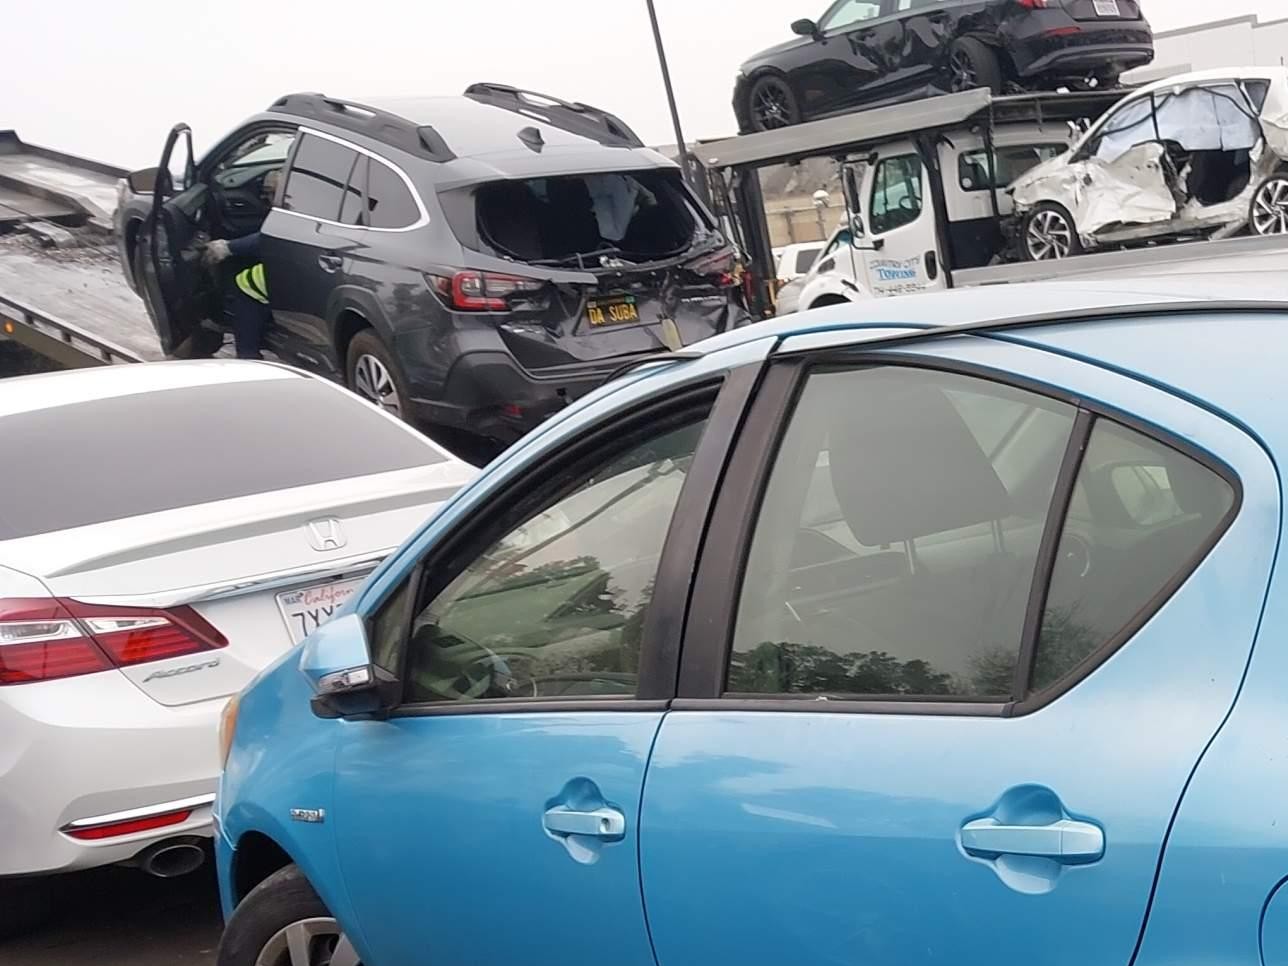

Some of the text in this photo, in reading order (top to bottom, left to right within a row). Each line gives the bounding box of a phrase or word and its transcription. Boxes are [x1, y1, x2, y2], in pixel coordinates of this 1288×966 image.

[588, 303, 638, 324] DA SUBA
[143, 656, 220, 683] Accord
